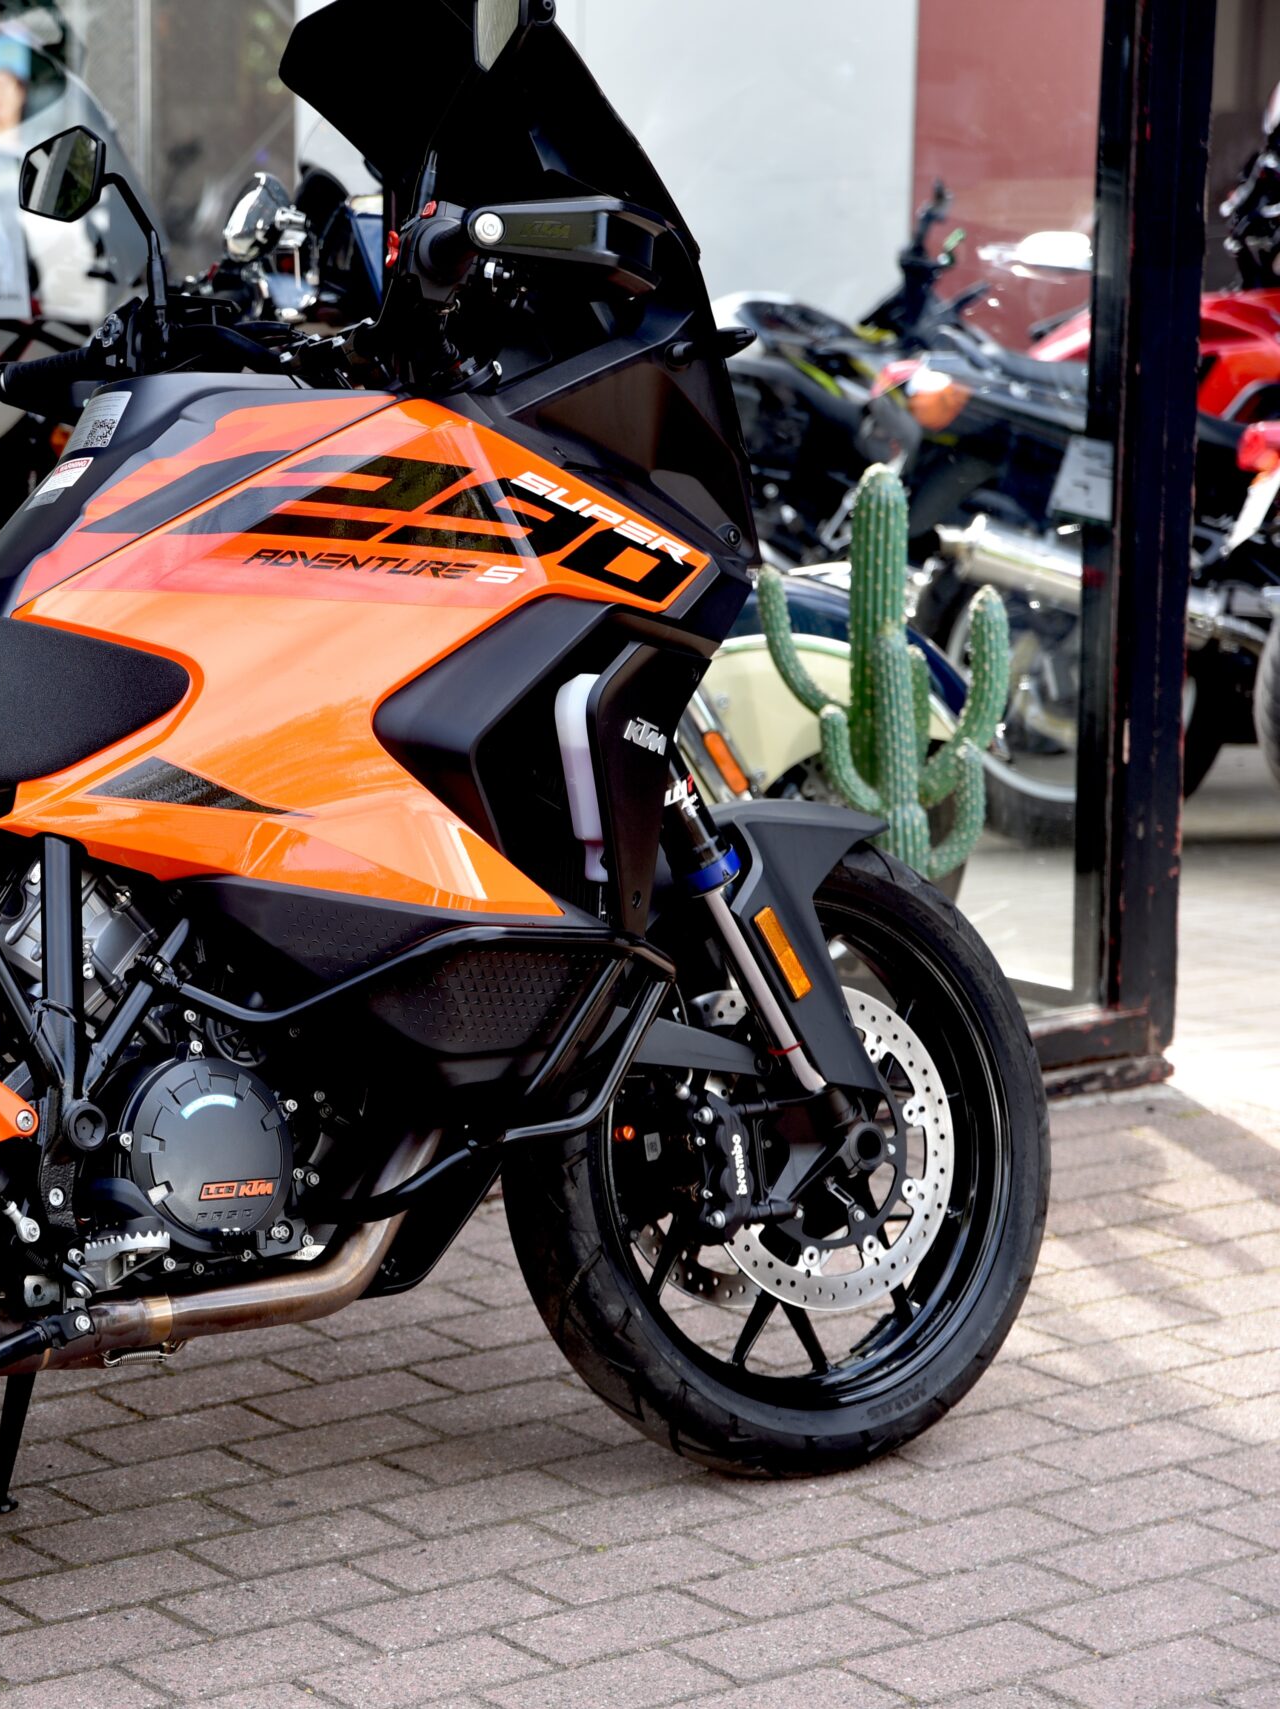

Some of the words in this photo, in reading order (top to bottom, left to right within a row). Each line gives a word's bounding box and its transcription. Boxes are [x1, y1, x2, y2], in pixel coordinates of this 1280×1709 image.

[510, 470, 694, 565] SUPER
[242, 548, 479, 580] ADVENTURE
[475, 565, 526, 585] S
[623, 716, 667, 756] KTM
[731, 1133, 748, 1195] brembo
[238, 1179, 273, 1197] KTM
